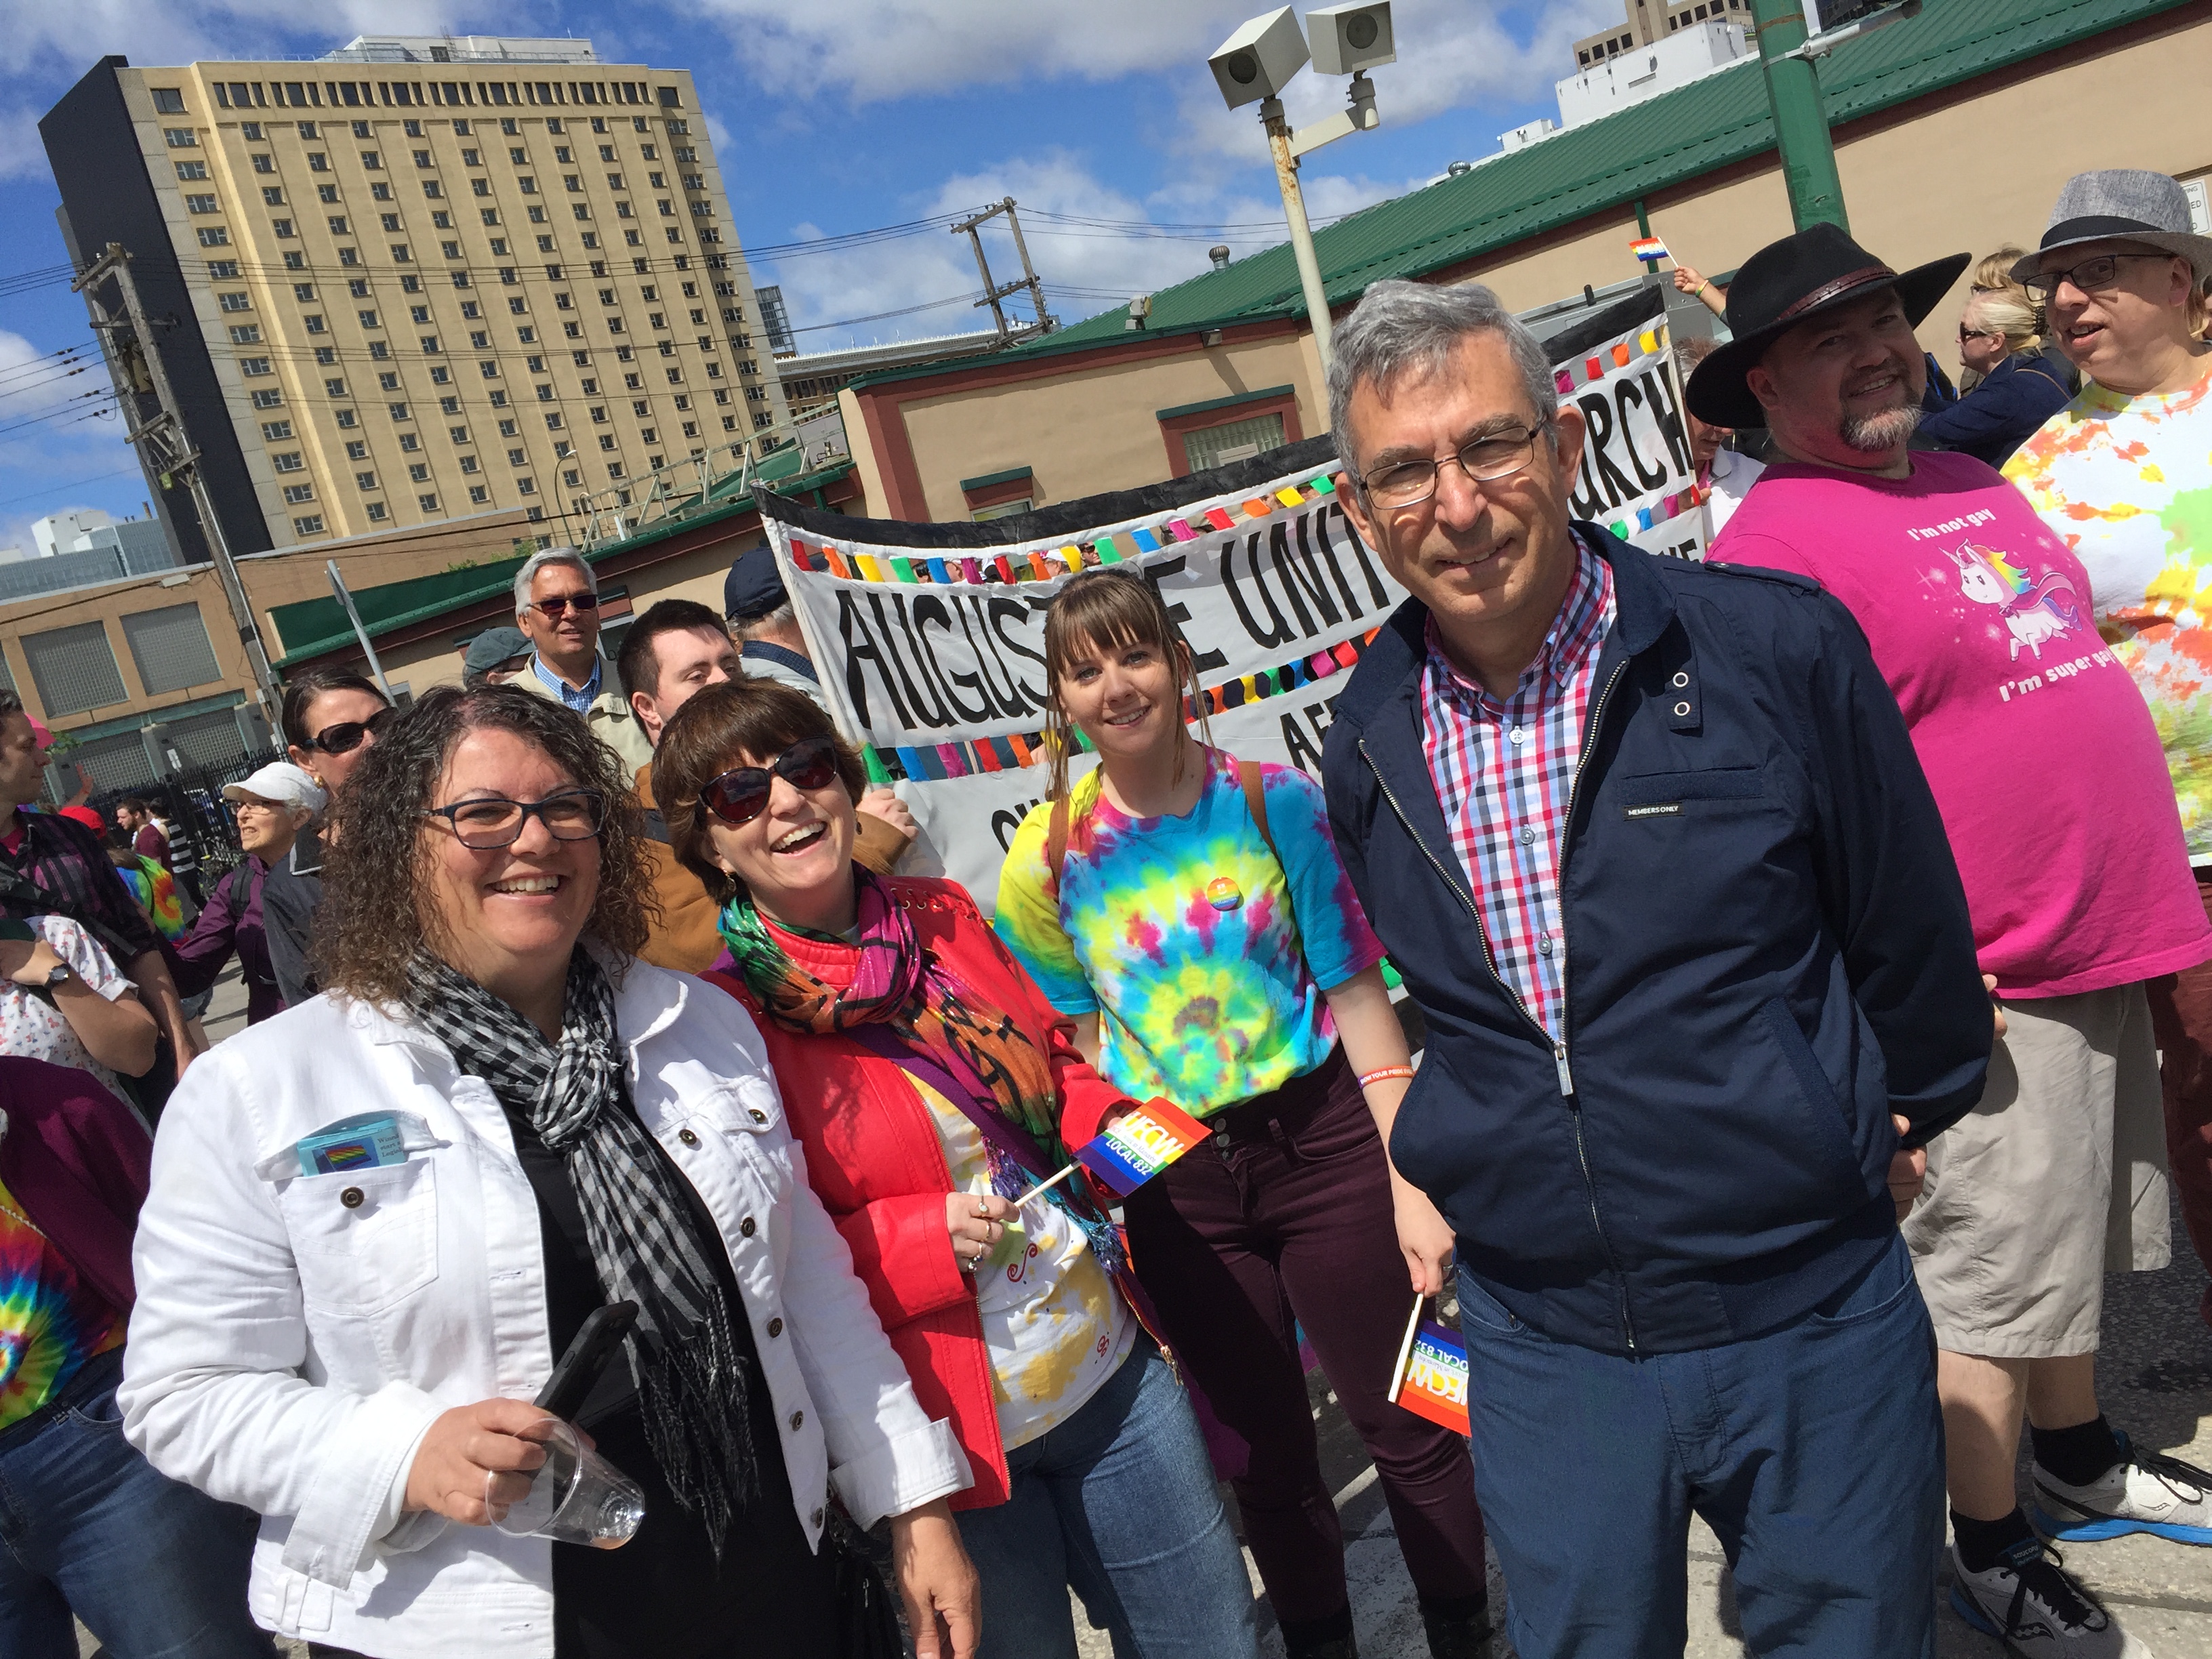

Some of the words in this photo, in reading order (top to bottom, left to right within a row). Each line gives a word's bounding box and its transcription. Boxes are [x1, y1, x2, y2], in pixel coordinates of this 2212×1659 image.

[1906, 527, 1940, 541] I'm
[1937, 517, 1969, 533] not
[1966, 508, 1996, 527] gay
[1999, 675, 2043, 702] I'm
[2045, 656, 2093, 682] super
[1628, 807, 1660, 815] MEMBERS
[1372, 1071, 1388, 1079] YOUR
[1122, 1111, 1185, 1158] UFCW
[1105, 1137, 1136, 1164] LOCAL
[1132, 1158, 1153, 1176] 832
[1437, 1349, 1468, 1371] OCAL
[2013, 1545, 2039, 1559] saucony
